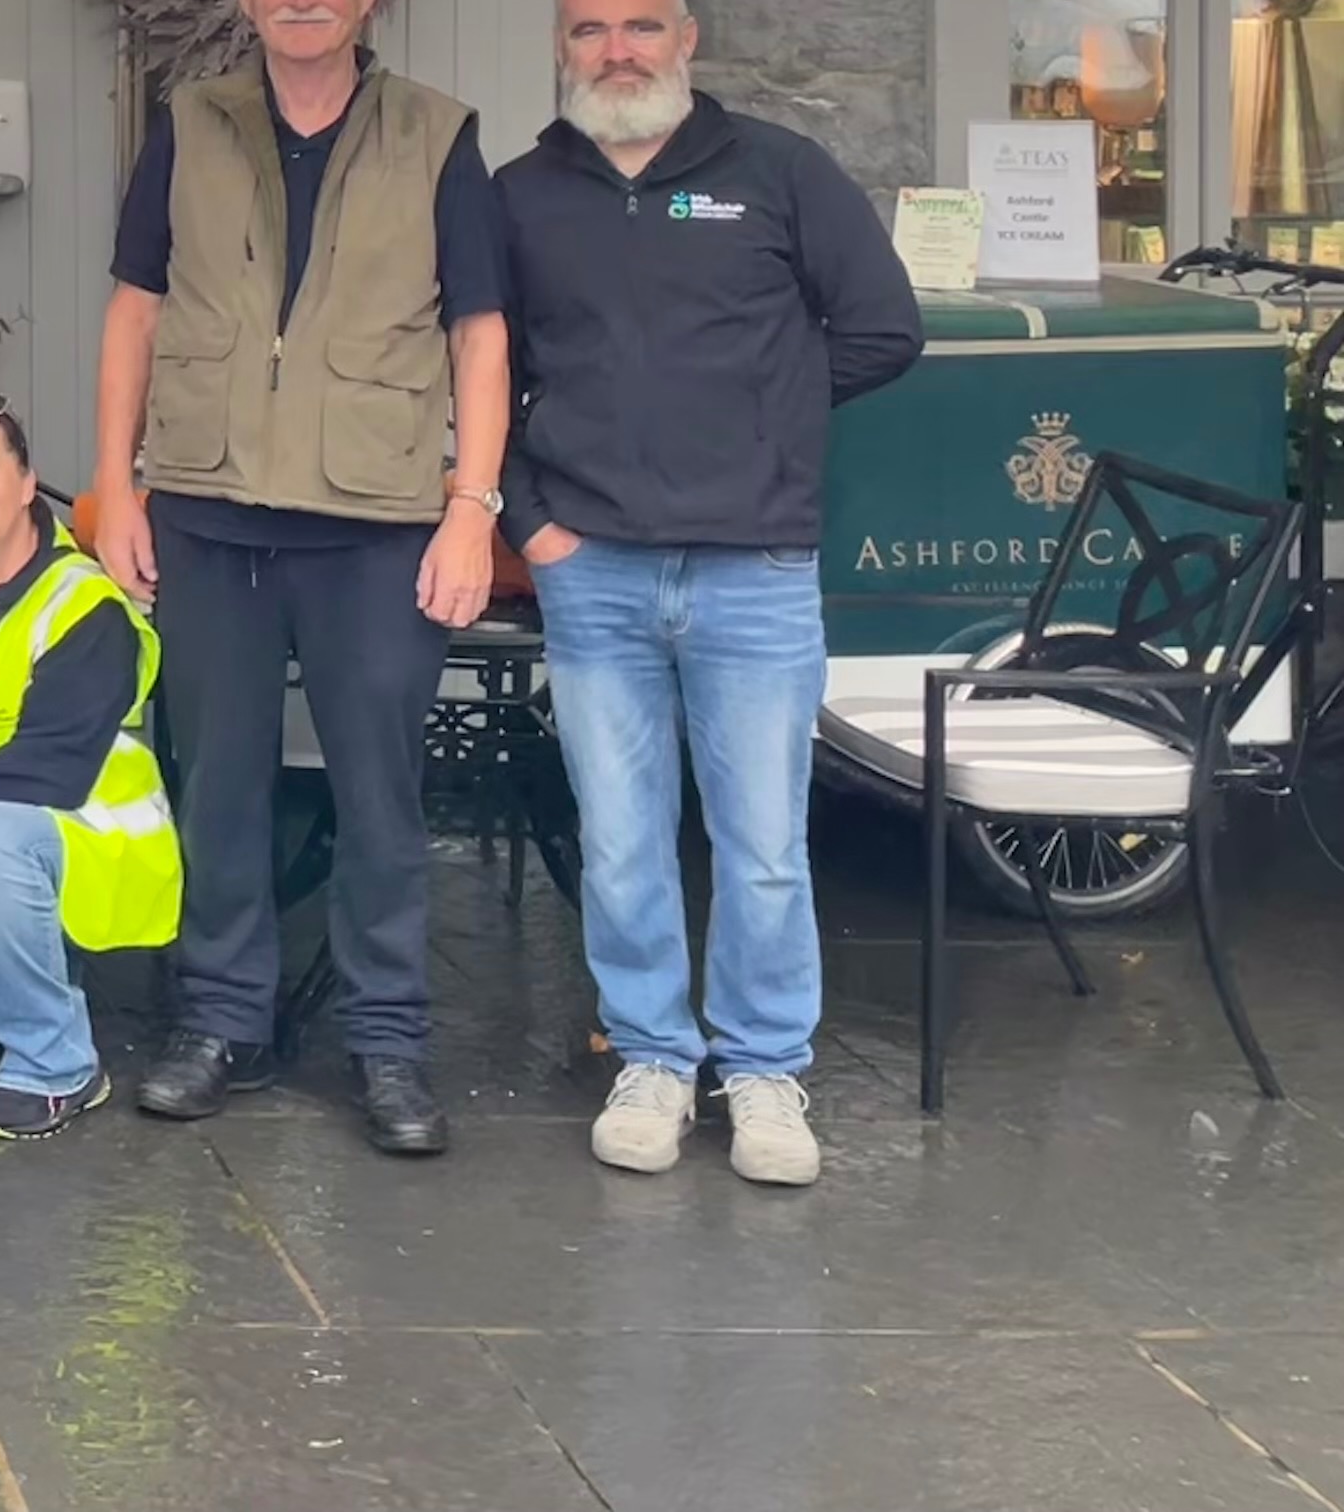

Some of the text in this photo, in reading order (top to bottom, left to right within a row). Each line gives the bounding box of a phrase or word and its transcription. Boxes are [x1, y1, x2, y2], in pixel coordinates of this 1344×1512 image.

[1019, 230, 1065, 241] CREAM
[854, 527, 1244, 570] ASHFORD CAE
